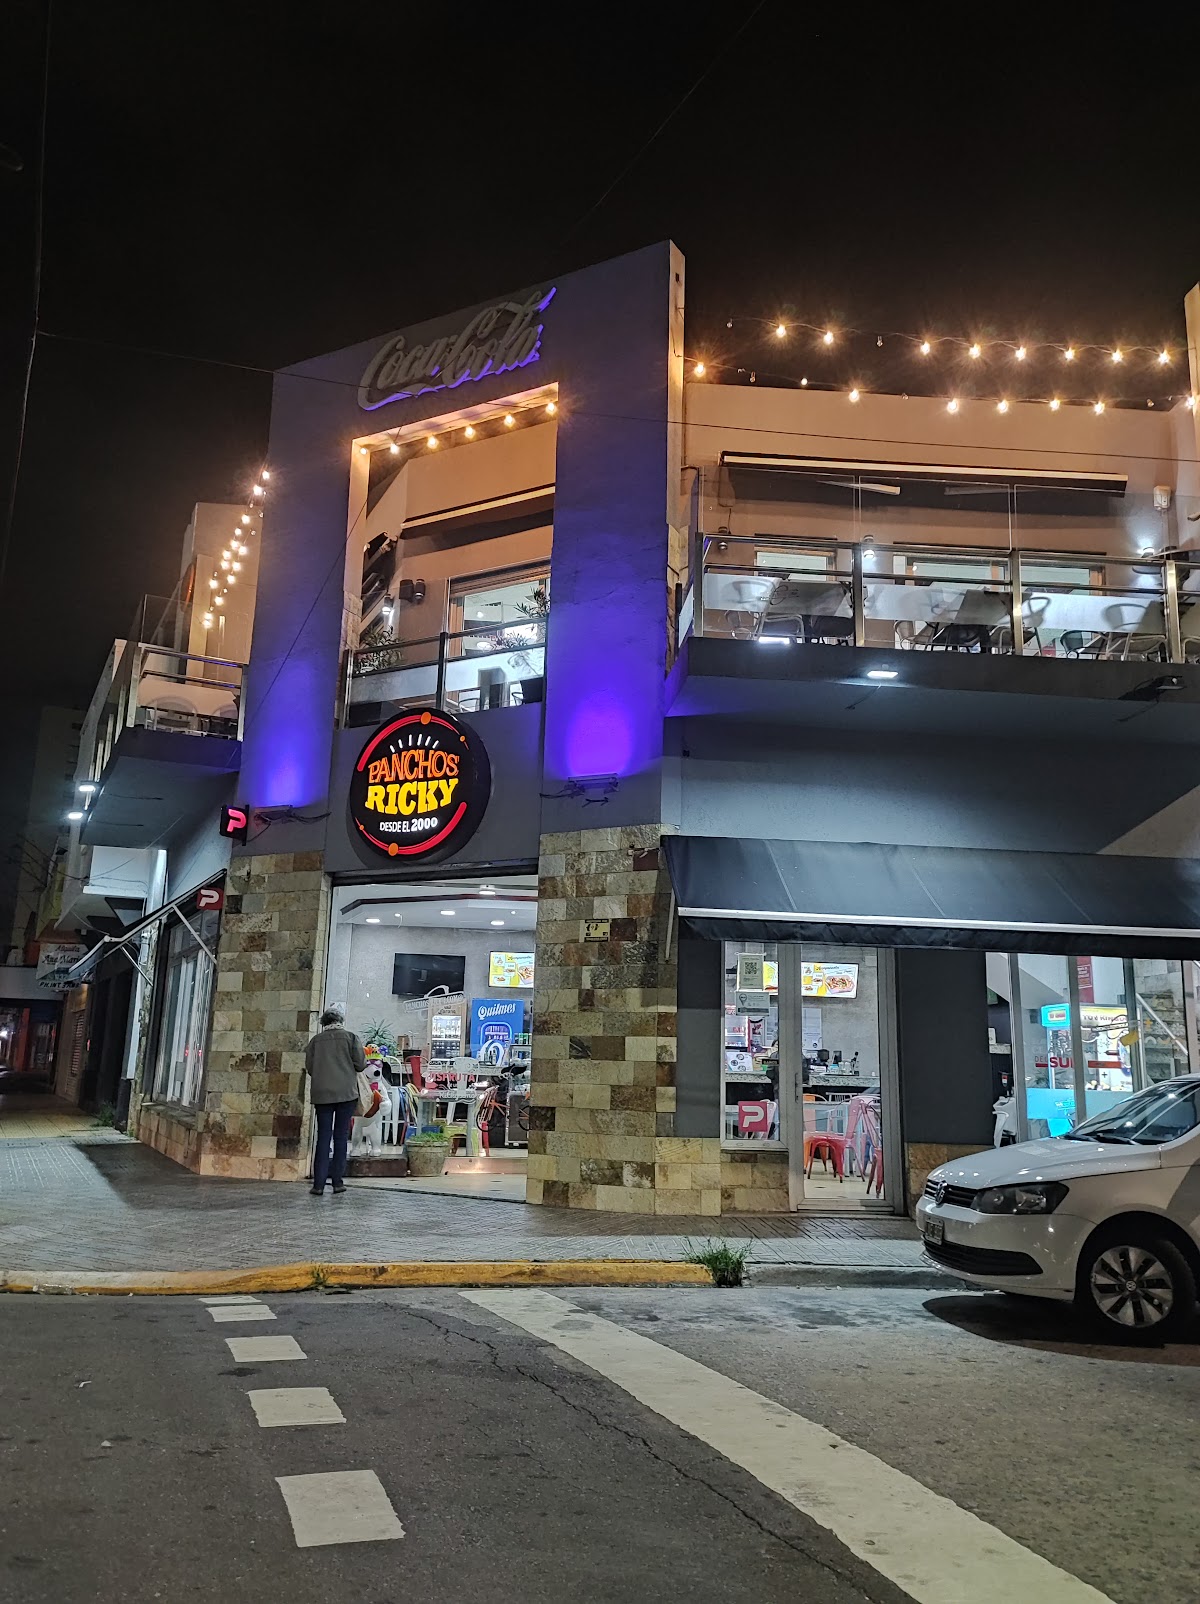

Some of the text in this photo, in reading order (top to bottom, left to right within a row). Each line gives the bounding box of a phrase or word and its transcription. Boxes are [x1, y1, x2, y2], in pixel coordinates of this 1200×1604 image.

[368, 749, 460, 783] PANCHOS
[365, 778, 459, 815] RICKY
[380, 817, 438, 832] DESDE EL 2000
[478, 1003, 516, 1020] Quilmes
[742, 1106, 765, 1127] P
